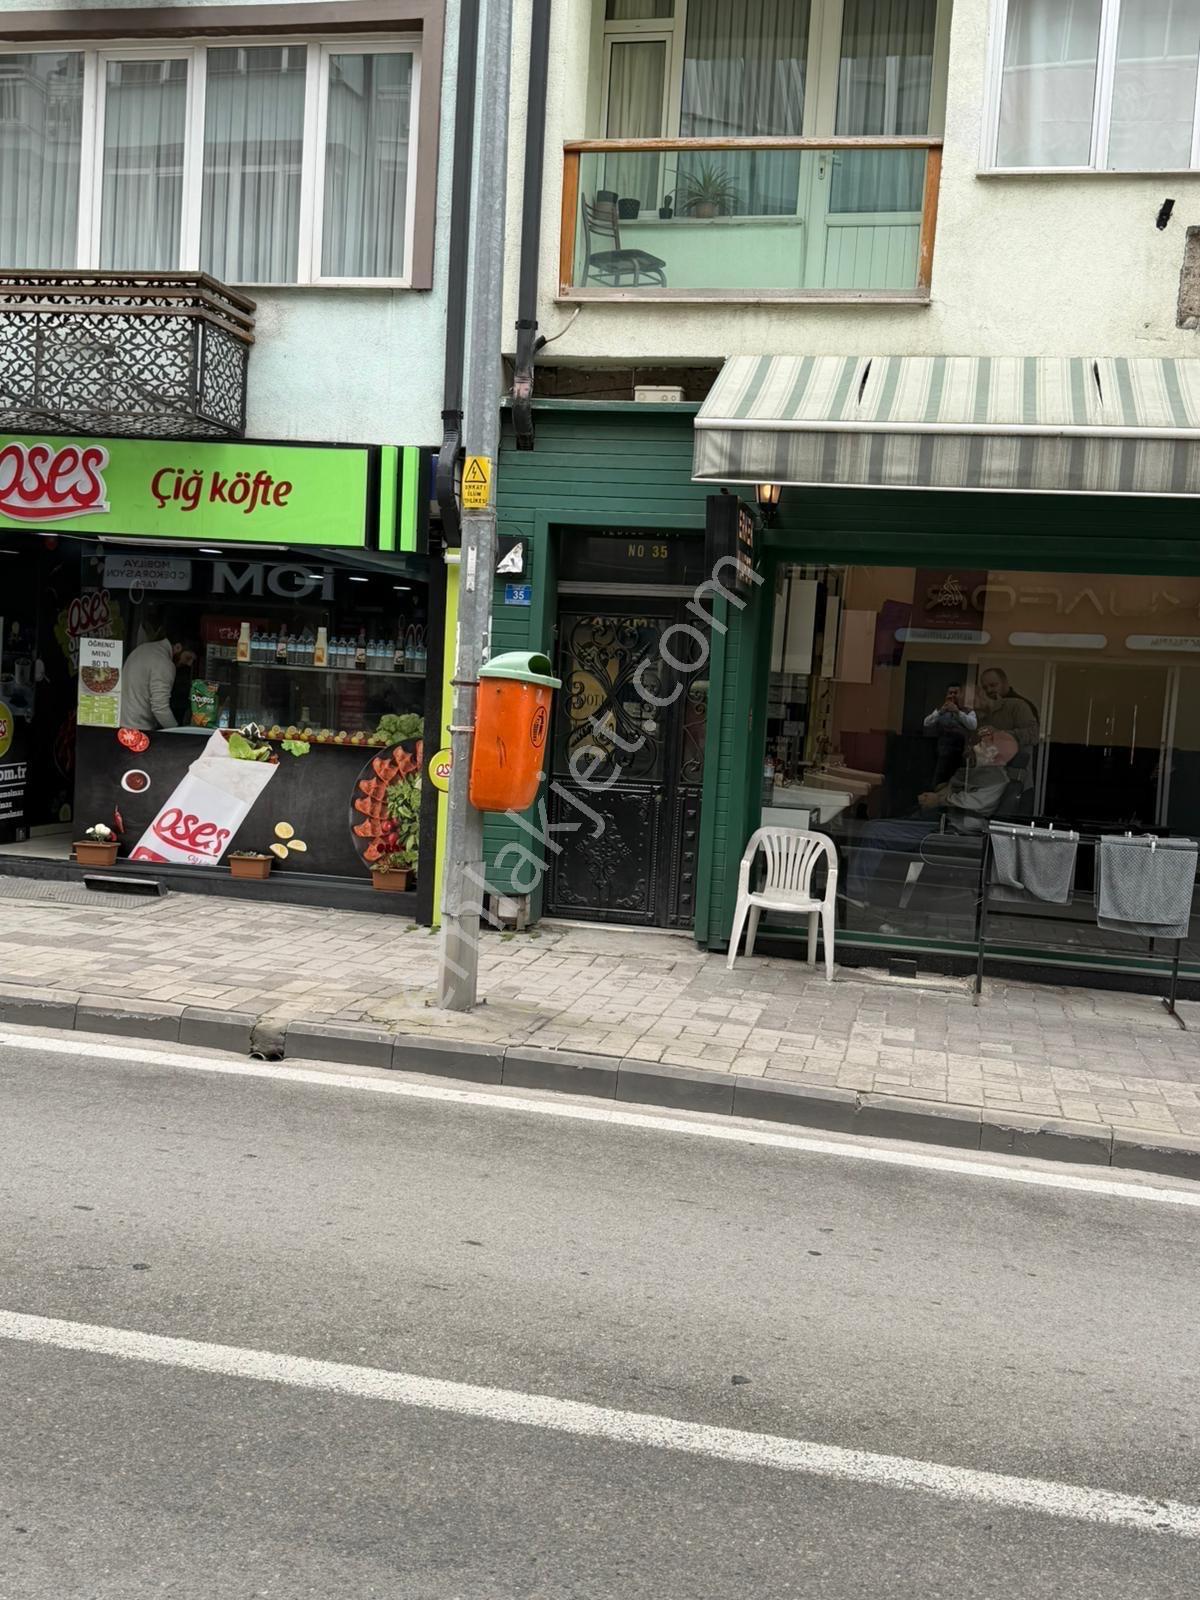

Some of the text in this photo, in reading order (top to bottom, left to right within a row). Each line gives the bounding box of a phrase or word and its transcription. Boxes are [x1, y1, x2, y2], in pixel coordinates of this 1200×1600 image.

[151, 467, 292, 514] Çiğ köfte
[628, 544, 668, 558] NO 35
[512, 590, 525, 600] 35
